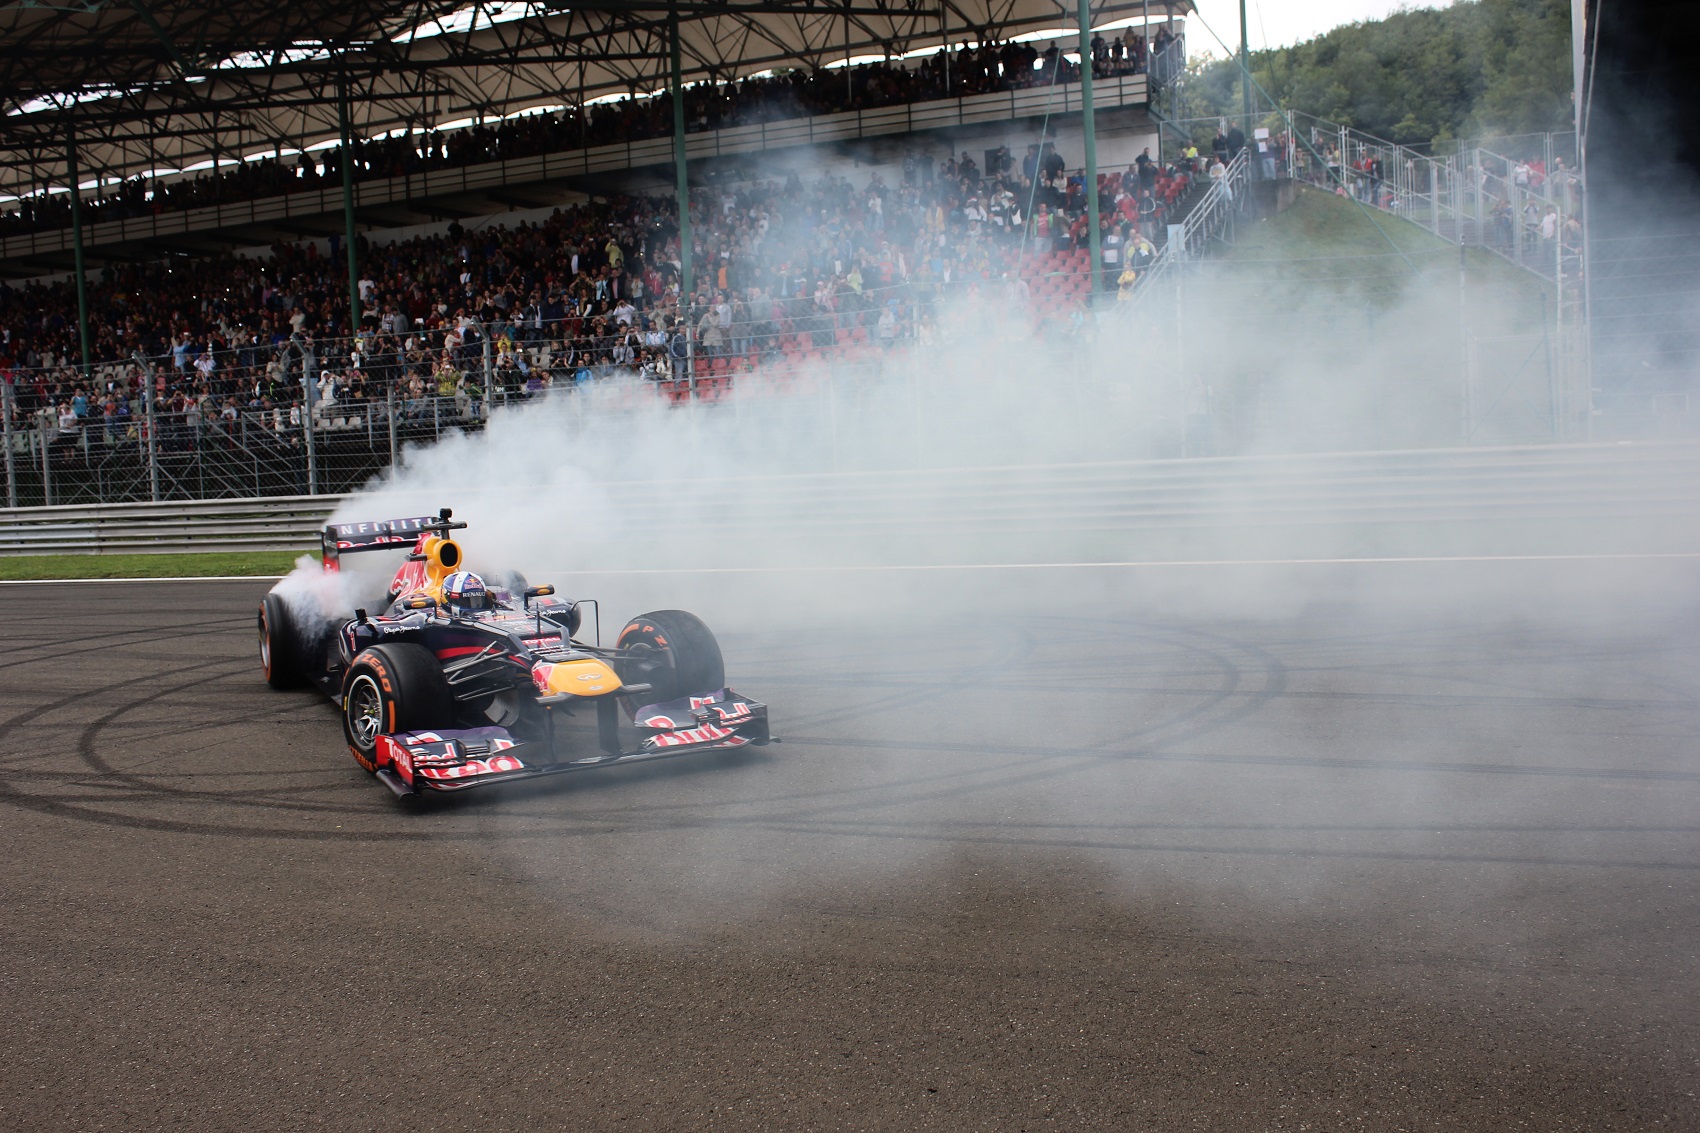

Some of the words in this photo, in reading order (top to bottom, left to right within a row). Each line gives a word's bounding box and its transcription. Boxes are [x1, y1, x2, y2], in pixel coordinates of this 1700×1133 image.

[340, 517, 433, 535] NFINITI
[361, 653, 393, 693] ZERO
[384, 737, 413, 774] TOTAL
